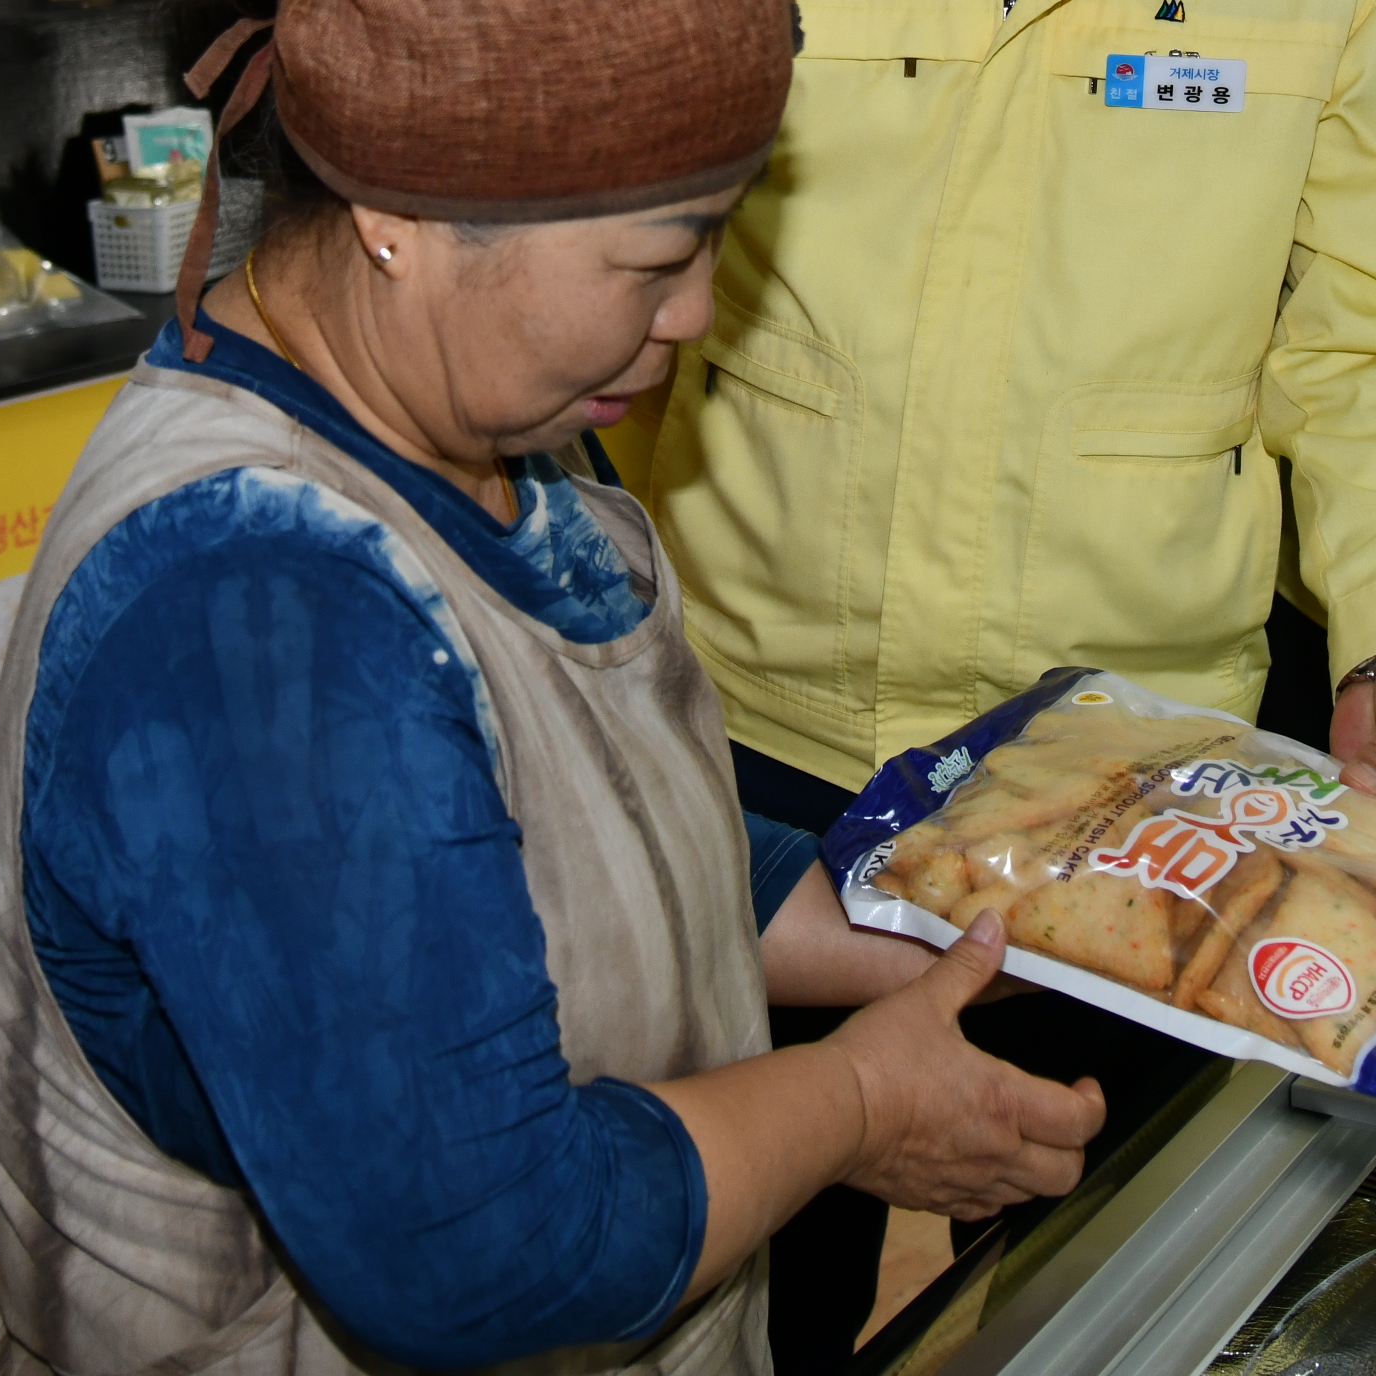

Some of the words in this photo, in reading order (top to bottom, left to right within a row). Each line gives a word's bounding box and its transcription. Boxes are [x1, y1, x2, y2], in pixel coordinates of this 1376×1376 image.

[1169, 67, 1220, 81] 거제시장
[1110, 780, 1155, 817] SPROUT
[1084, 815, 1113, 846] FISH
[1096, 788, 1288, 892] 어묵
[1055, 844, 1089, 883] CAKE
[1289, 962, 1328, 1001] HACCP
